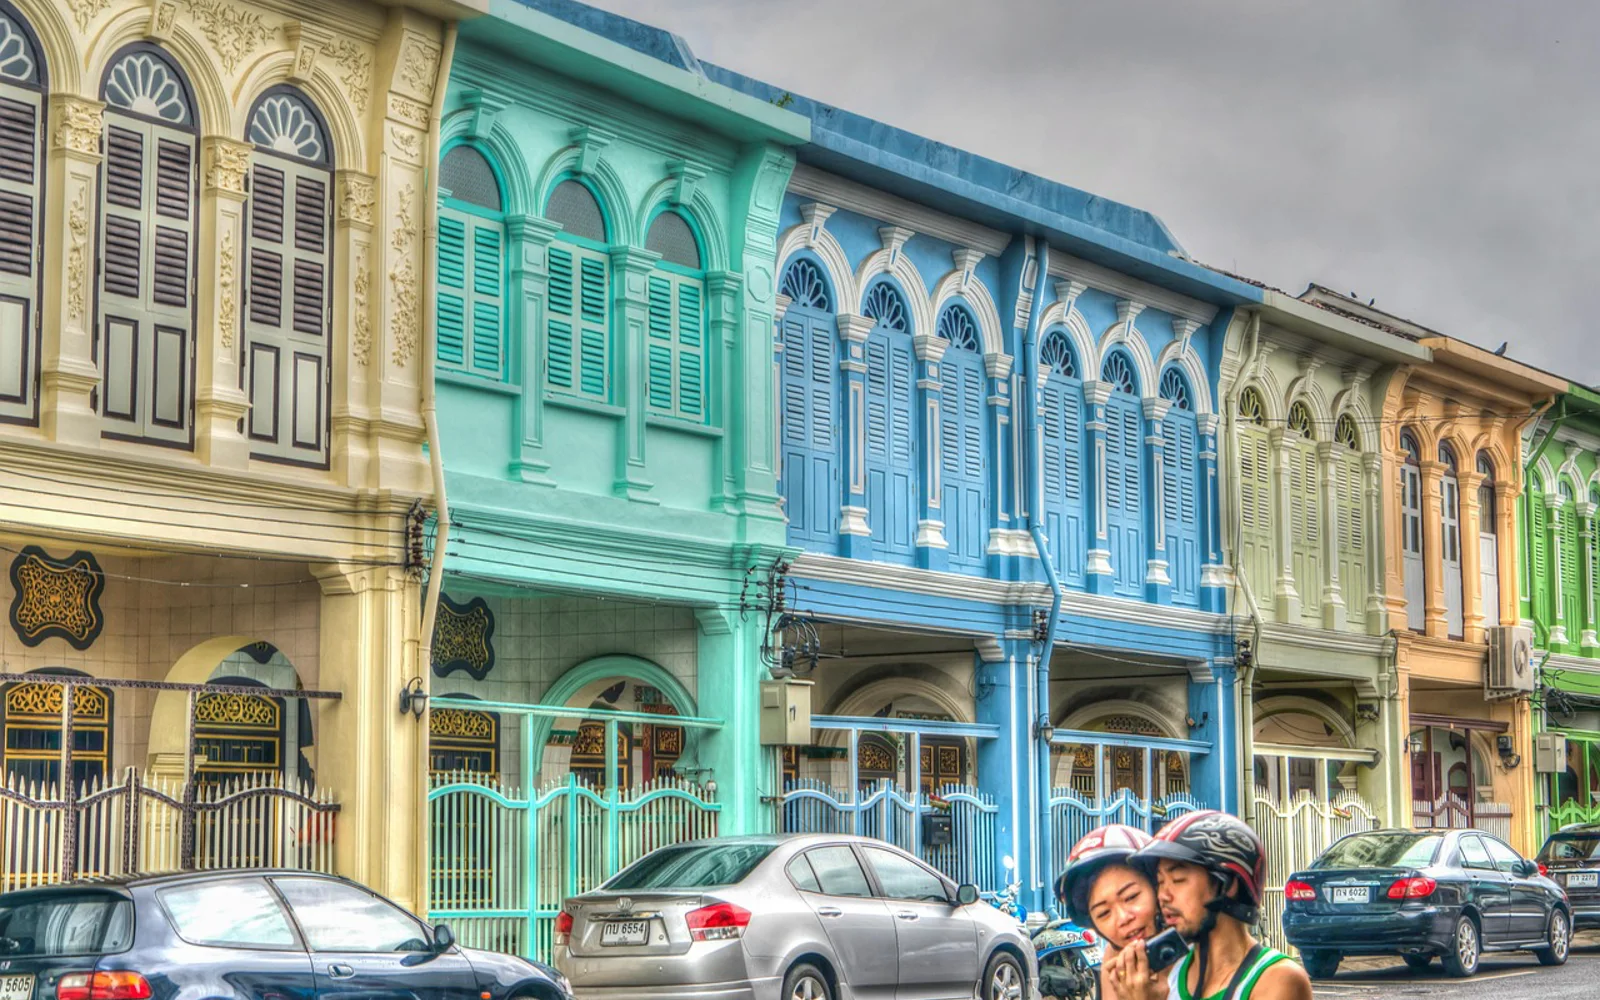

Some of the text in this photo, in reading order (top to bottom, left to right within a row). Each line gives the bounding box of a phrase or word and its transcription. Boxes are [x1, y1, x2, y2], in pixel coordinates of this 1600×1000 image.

[1349, 888, 1367, 896] 6022
[621, 922, 646, 934] 6554
[5, 977, 31, 992] 5605
